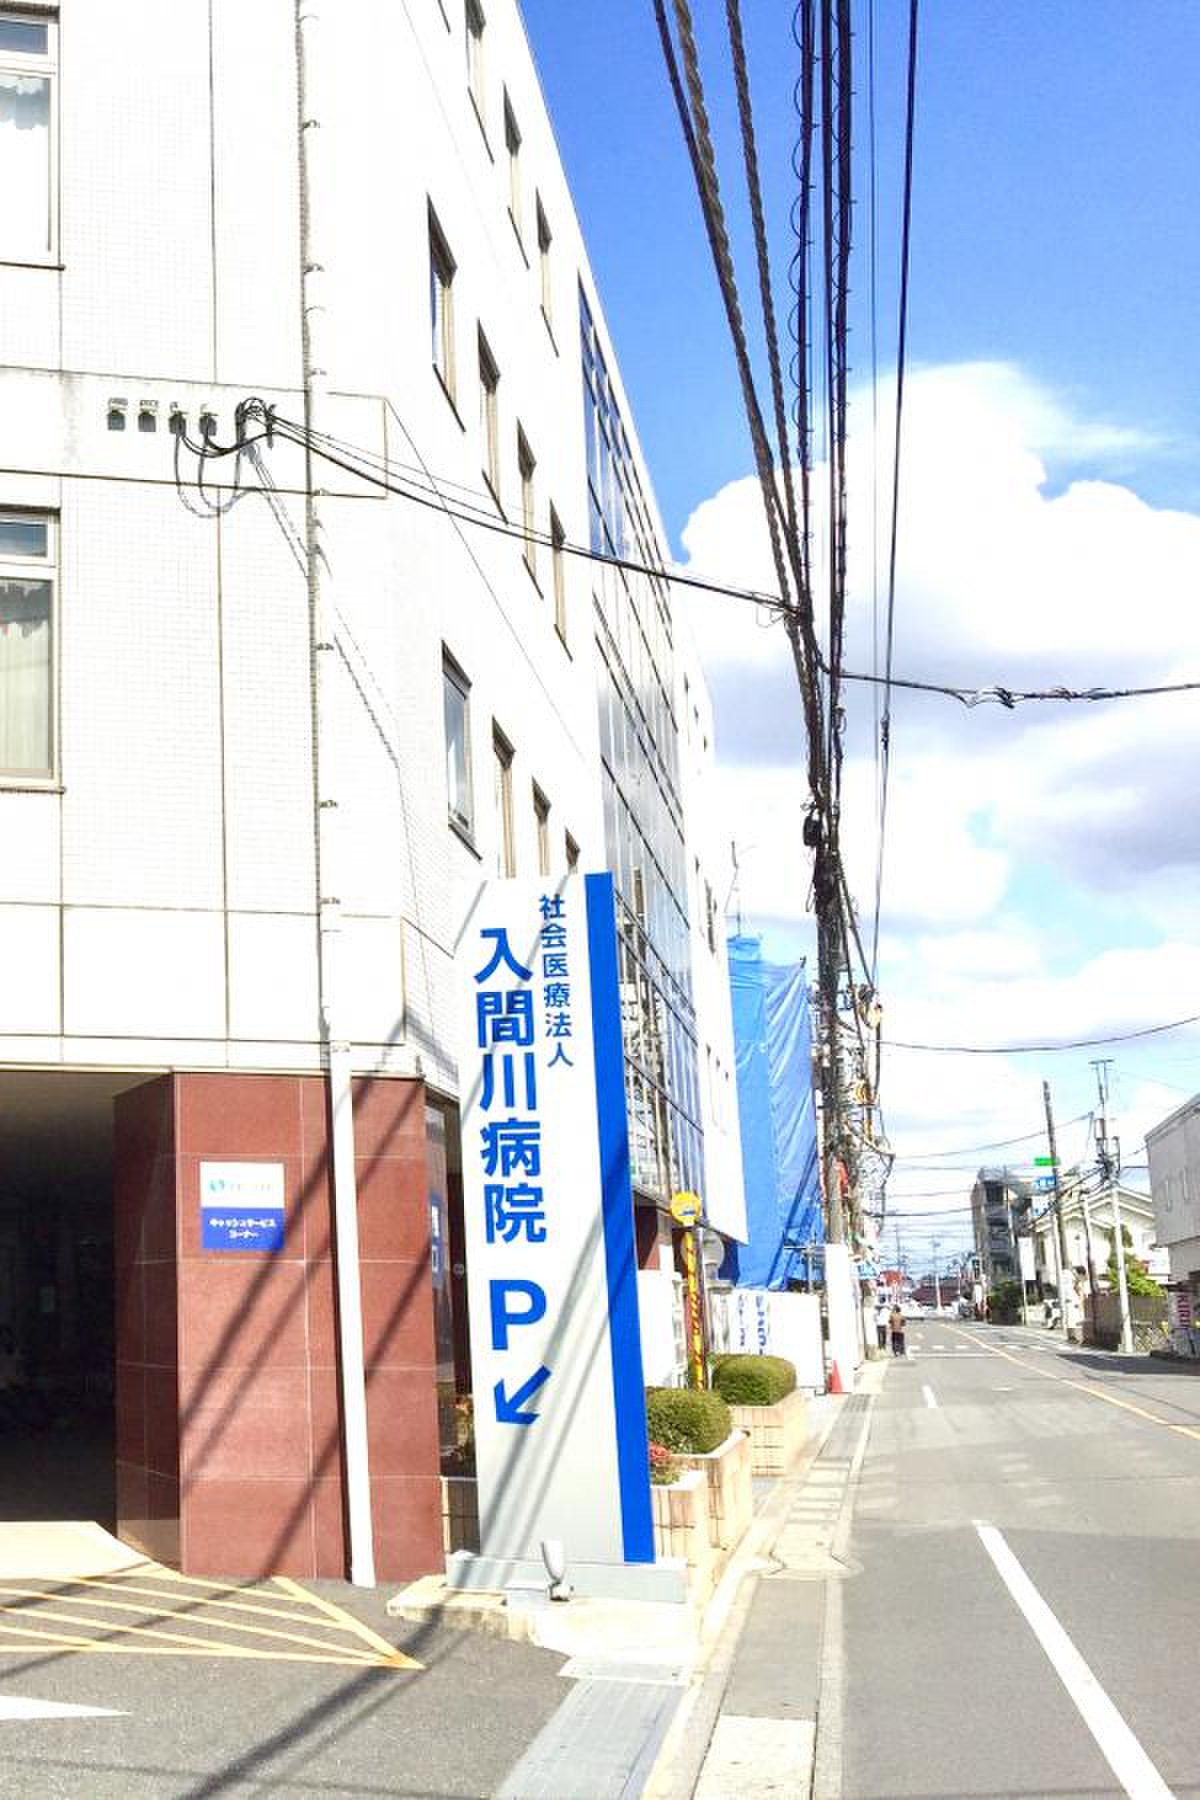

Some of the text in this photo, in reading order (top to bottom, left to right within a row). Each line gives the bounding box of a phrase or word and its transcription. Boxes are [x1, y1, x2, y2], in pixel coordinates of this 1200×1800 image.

[538, 892, 574, 1068] 社会医療法人
[473, 927, 547, 1244] 入間川病院
[489, 1279, 547, 1350] P
